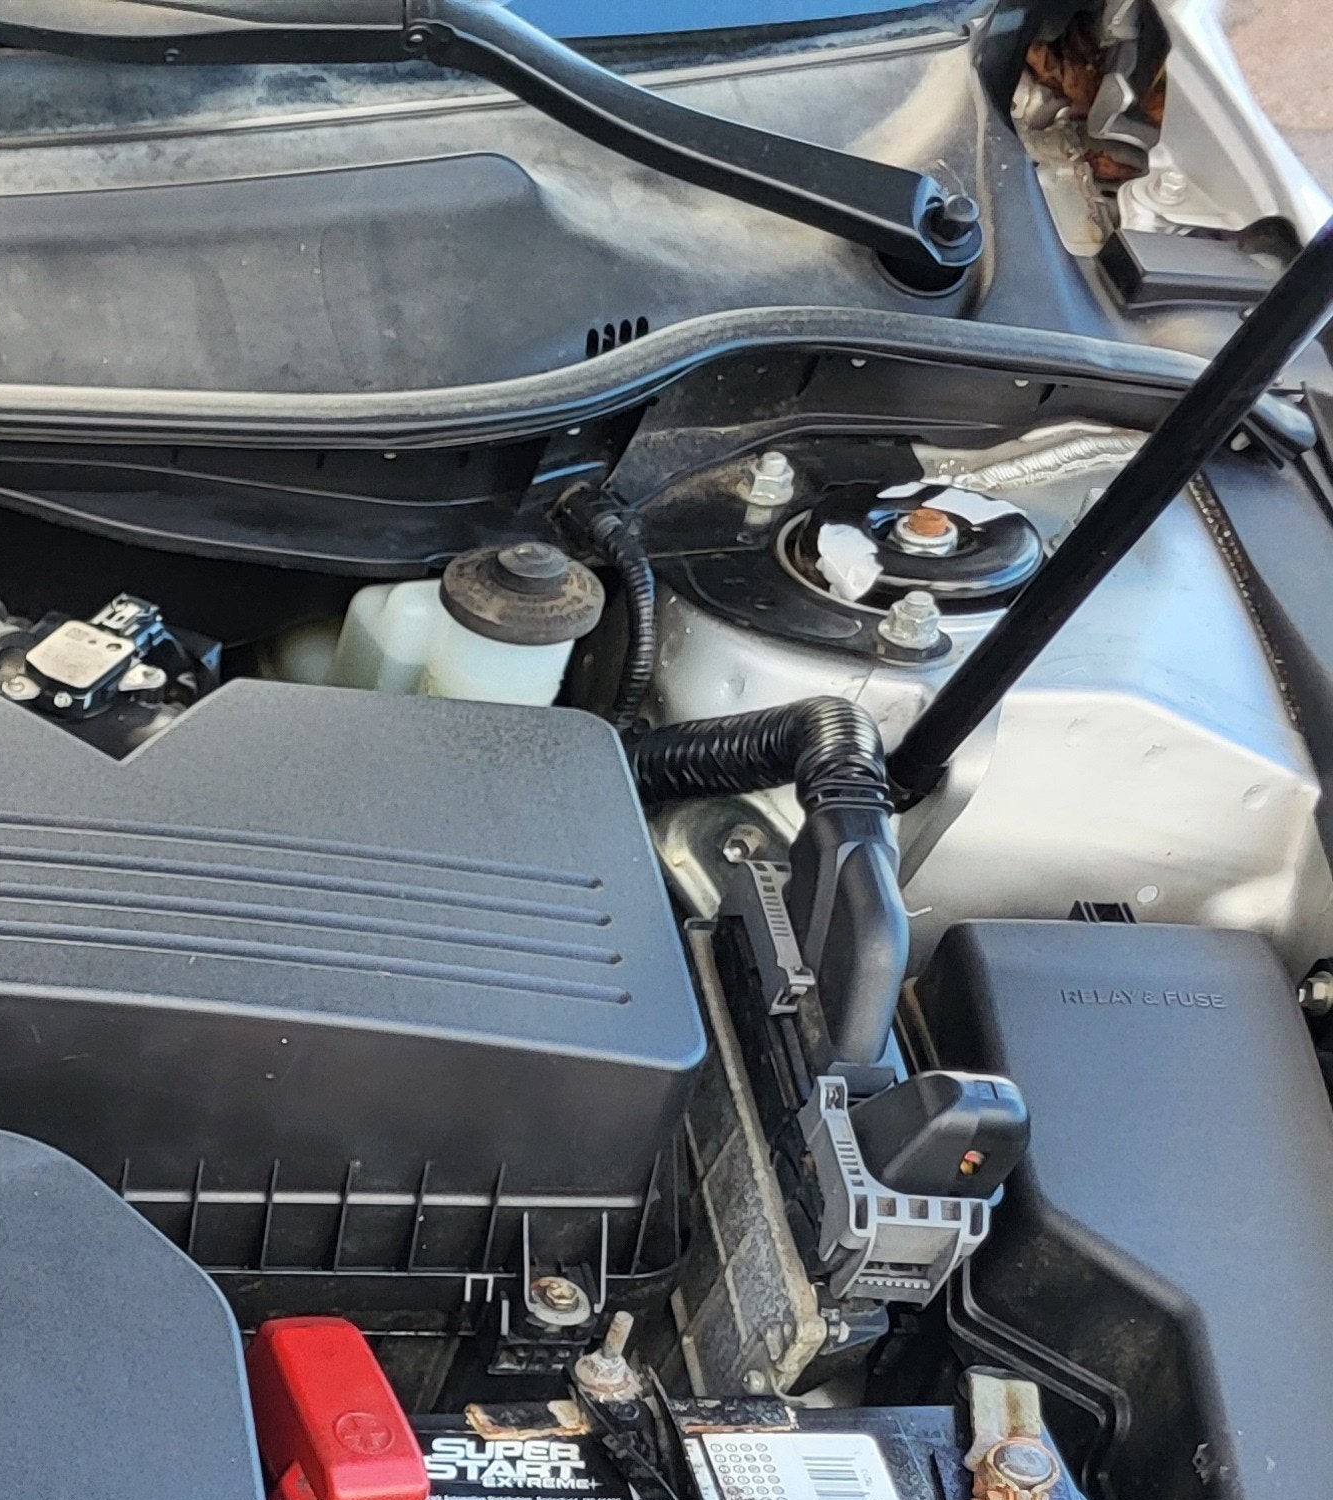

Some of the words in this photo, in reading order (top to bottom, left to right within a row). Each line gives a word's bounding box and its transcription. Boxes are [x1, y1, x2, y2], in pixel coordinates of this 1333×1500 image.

[1060, 989, 1133, 1005] RELAY
[1142, 991, 1159, 1006] &
[1162, 990, 1227, 1009] FUSE
[431, 1437, 581, 1461] SUPER
[423, 1455, 586, 1482] START
